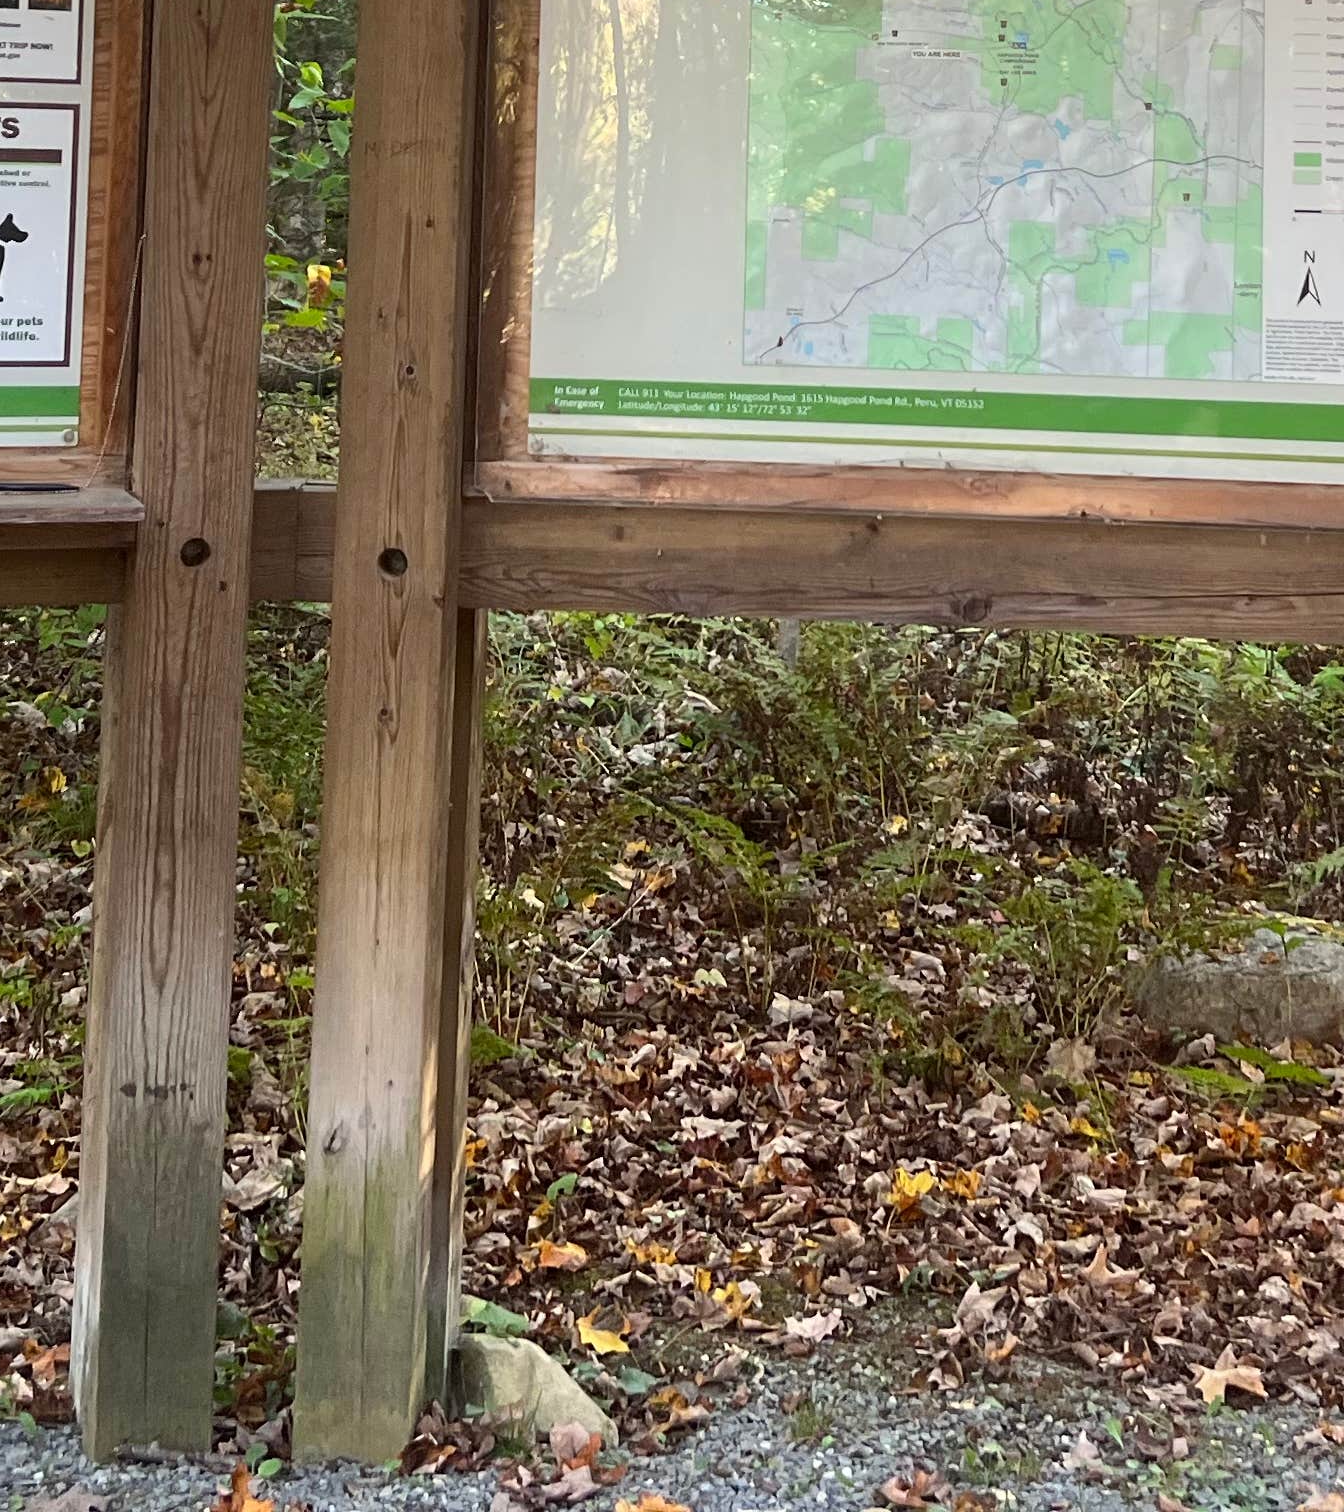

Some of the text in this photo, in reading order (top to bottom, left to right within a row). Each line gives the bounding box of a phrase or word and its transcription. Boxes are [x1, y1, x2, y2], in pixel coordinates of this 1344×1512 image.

[943, 51, 960, 59] HERE
[21, 169, 32, 178] or
[1304, 249, 1316, 264] N
[16, 315, 44, 329] pets
[554, 385, 599, 396] In Case of
[554, 397, 605, 410] Emergency
[618, 387, 640, 398] CALL
[642, 388, 659, 399] 911
[662, 389, 684, 400] Your
[729, 391, 771, 404] Hapgood
[869, 395, 893, 406] Pond
[940, 398, 954, 408] VT
